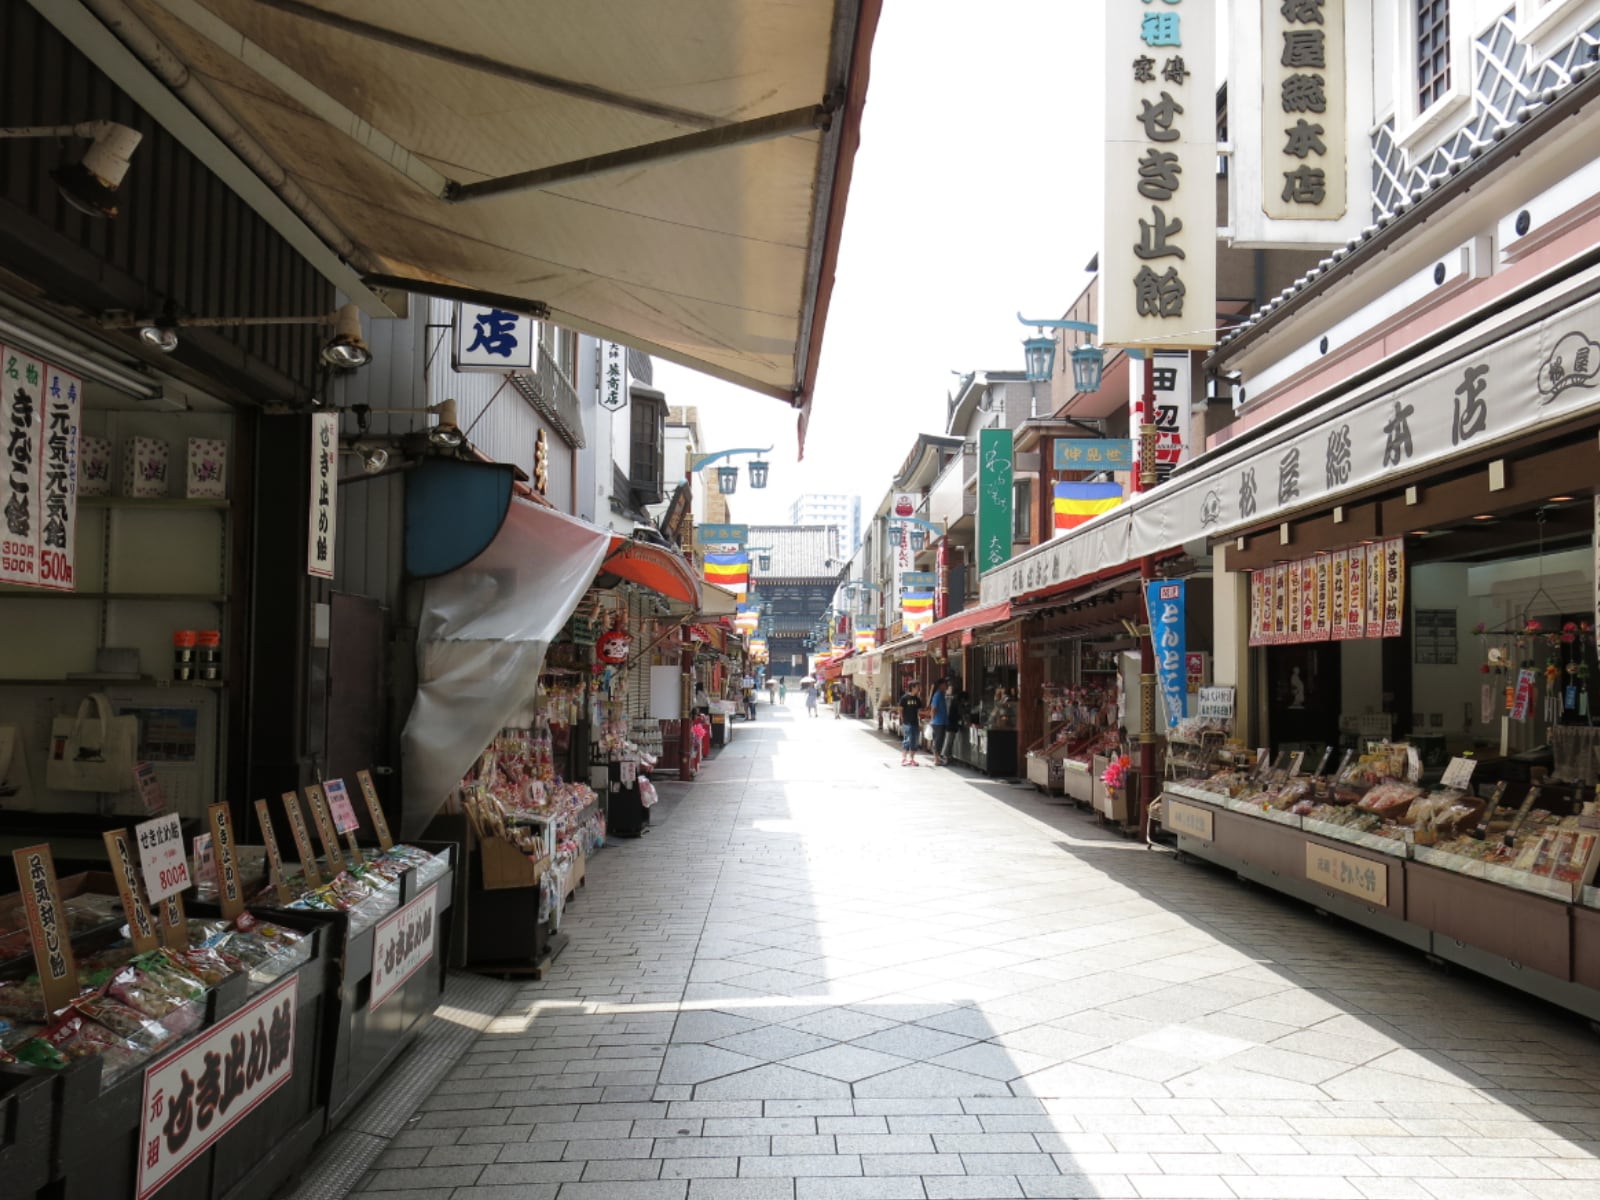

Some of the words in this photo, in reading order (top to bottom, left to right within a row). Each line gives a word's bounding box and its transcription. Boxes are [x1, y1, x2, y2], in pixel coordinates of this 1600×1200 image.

[1140, 0, 1182, 47] 祖
[1132, 91, 1186, 319] せき止飴
[466, 309, 518, 357] 店
[5, 355, 39, 387] 名物
[50, 375, 77, 404] 長寿
[4, 386, 34, 538] きなこ飴
[1063, 447, 1123, 463] 仲見世
[1238, 363, 1490, 519] 松屋総本店
[43, 403, 70, 549] 元気元気飴
[2, 541, 34, 558] 300円
[2, 557, 34, 575] 500円
[41, 550, 73, 584] 500円
[988, 535, 1004, 571] 大谷
[1348, 557, 1360, 623] とんとこ飴
[1386, 551, 1398, 620] せき止飴
[140, 821, 180, 849] せき止め飴
[159, 862, 188, 890] 800円
[384, 906, 432, 975] せき止め飴
[147, 1087, 164, 1169] 元祖
[162, 997, 291, 1155] せき止め飴
